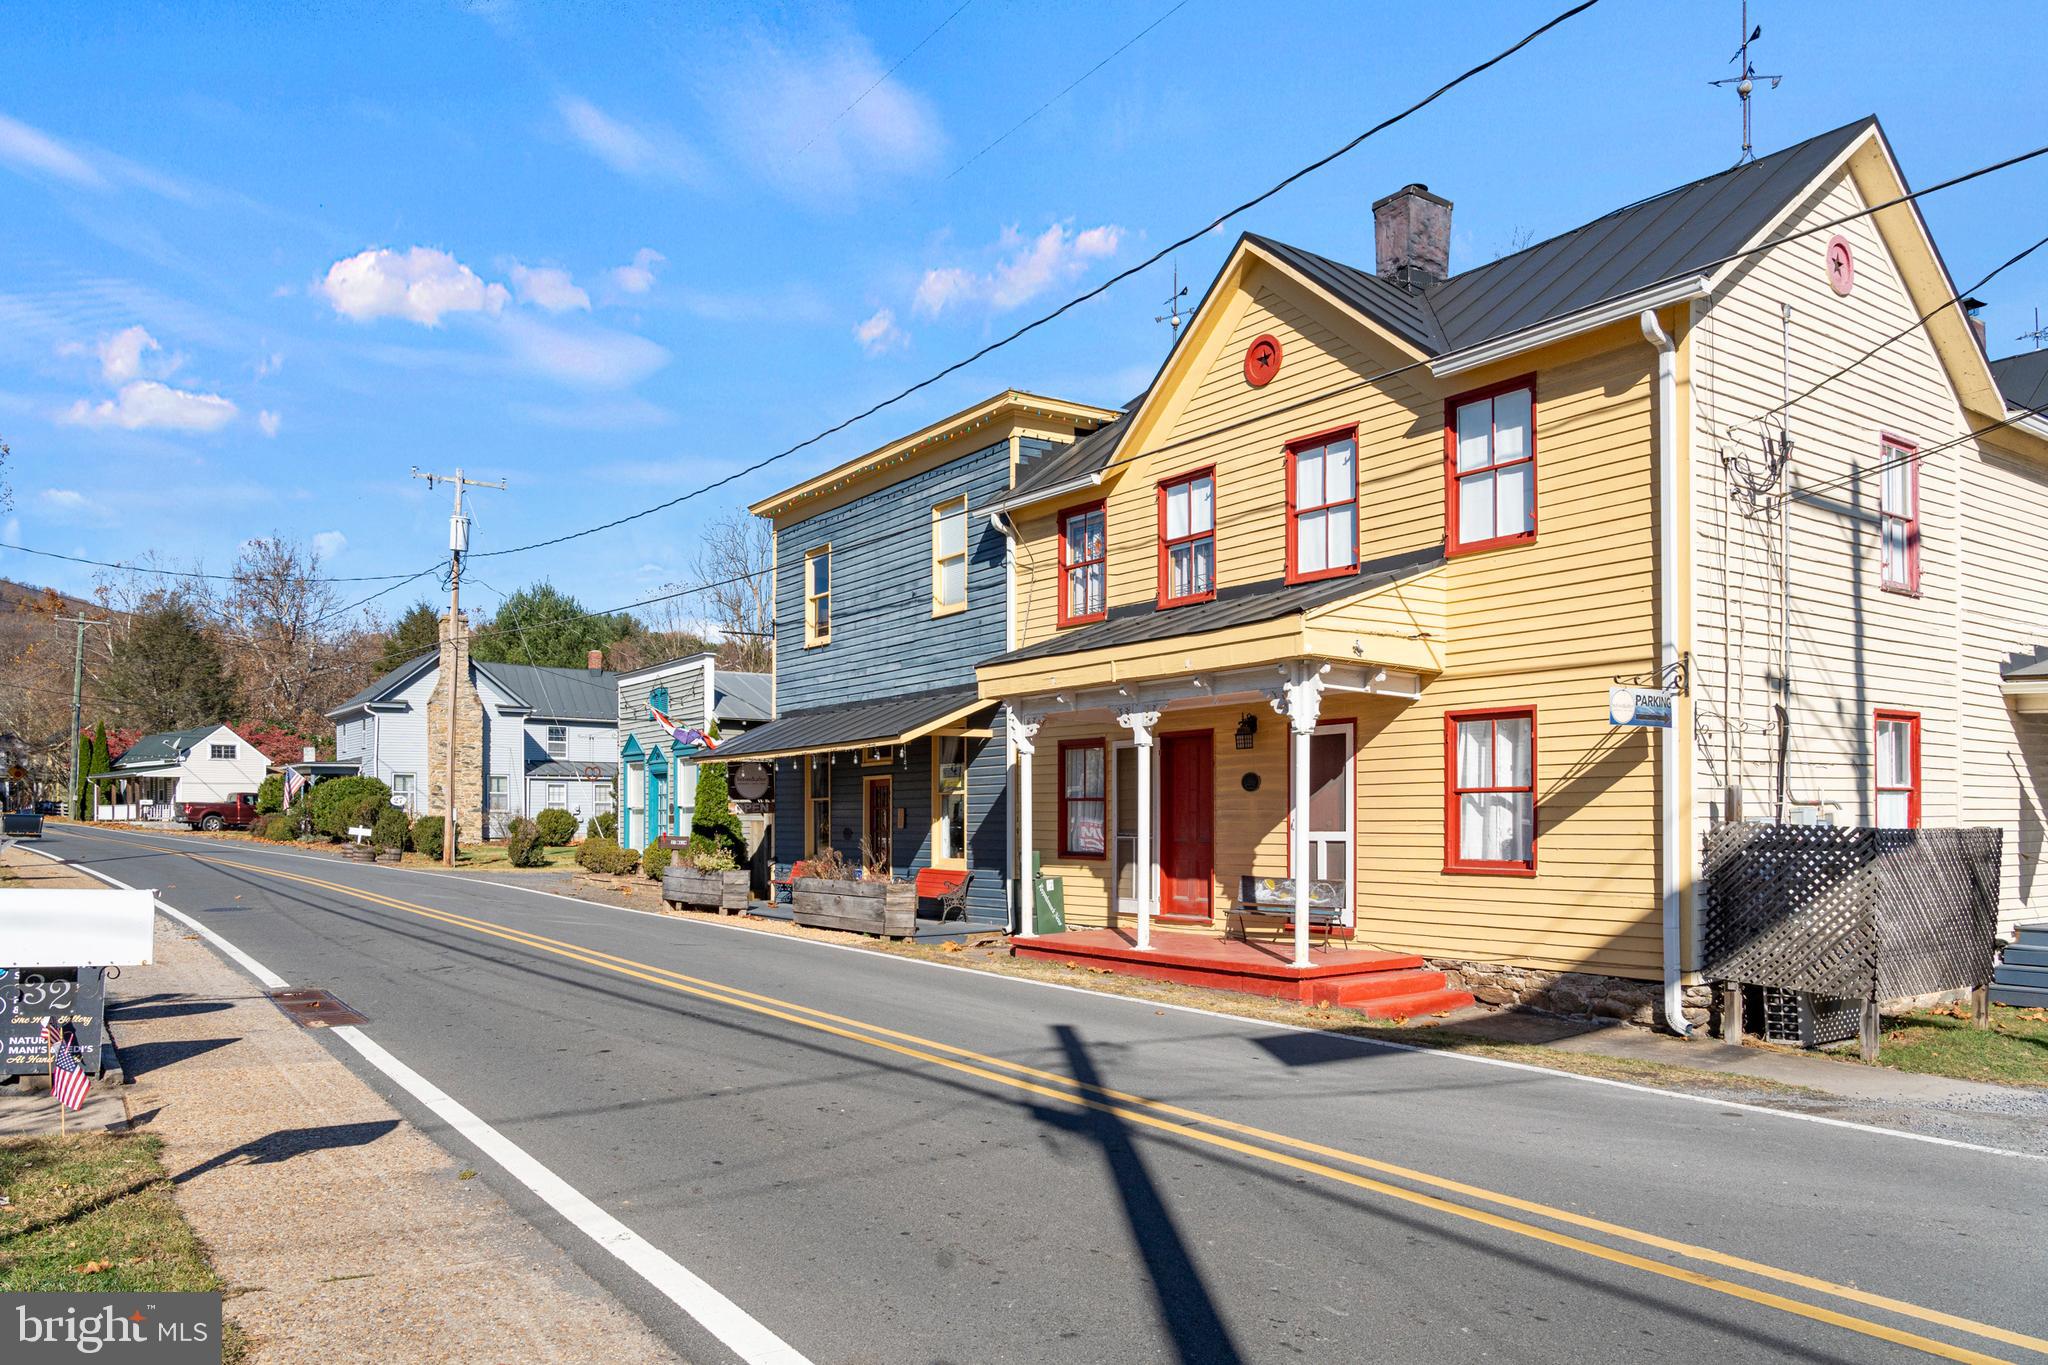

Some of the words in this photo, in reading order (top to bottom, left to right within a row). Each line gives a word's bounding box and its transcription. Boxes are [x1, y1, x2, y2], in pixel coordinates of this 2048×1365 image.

[1635, 694, 1671, 709] PARKING
[23, 973, 72, 1010] 32
[9, 1036, 48, 1045] NATUR
[8, 1046, 48, 1054] MANI'S
[66, 1044, 94, 1054] EDI'S
